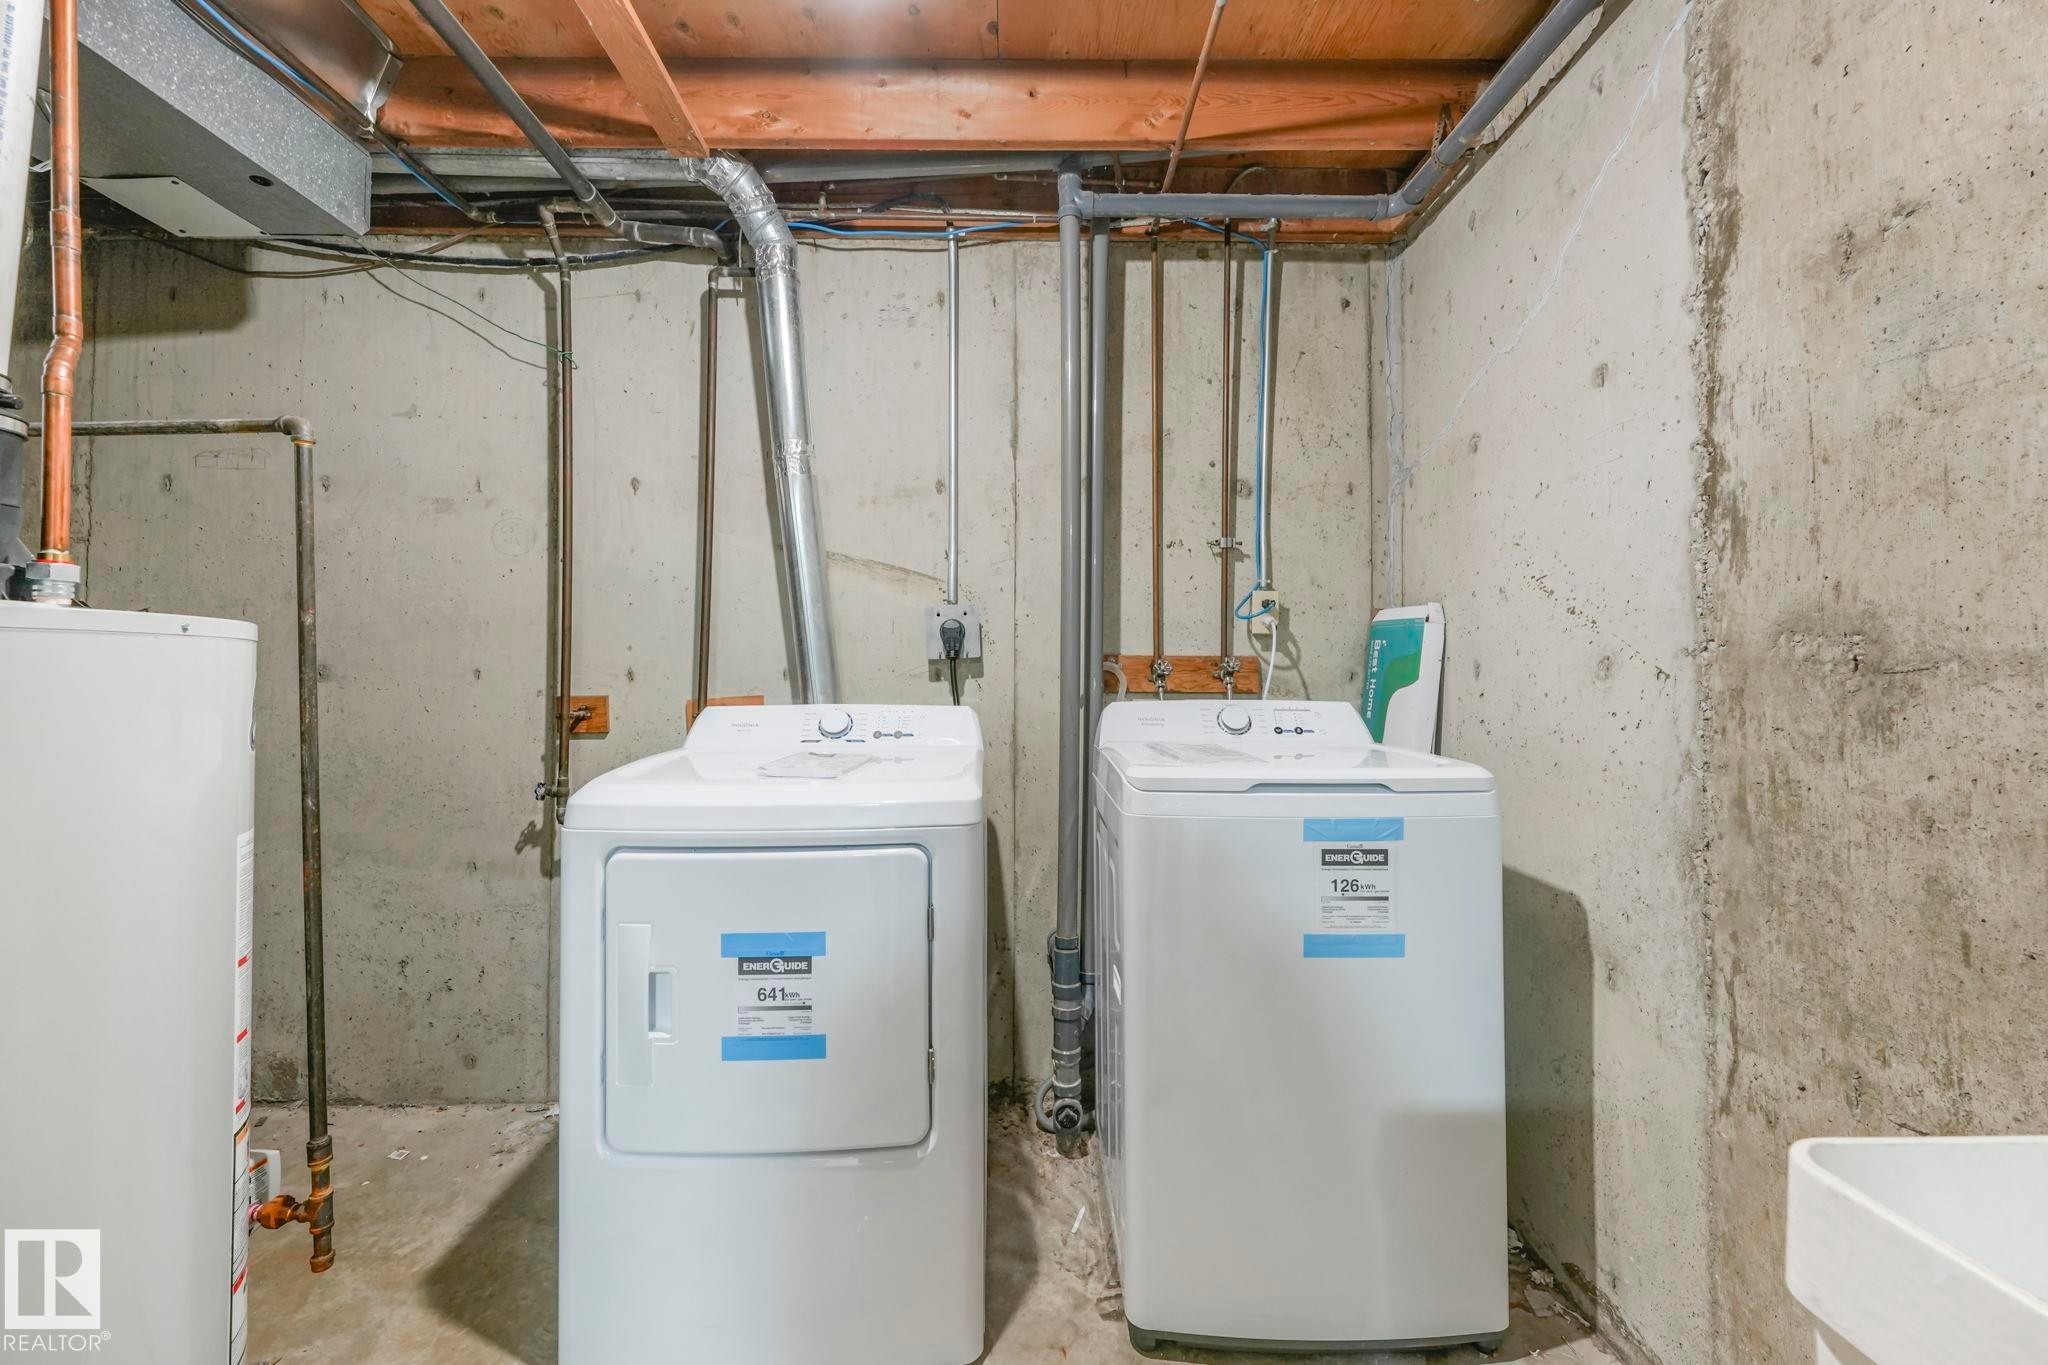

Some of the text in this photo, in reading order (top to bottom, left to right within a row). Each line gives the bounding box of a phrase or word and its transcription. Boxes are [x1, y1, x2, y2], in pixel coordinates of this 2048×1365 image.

[1366, 639, 1382, 719] Best Home
[1325, 850, 1385, 864] ENERGUIDE
[1331, 879, 1359, 892] 126
[743, 958, 808, 973] ENERGUIDE
[757, 987, 785, 1001] 641
